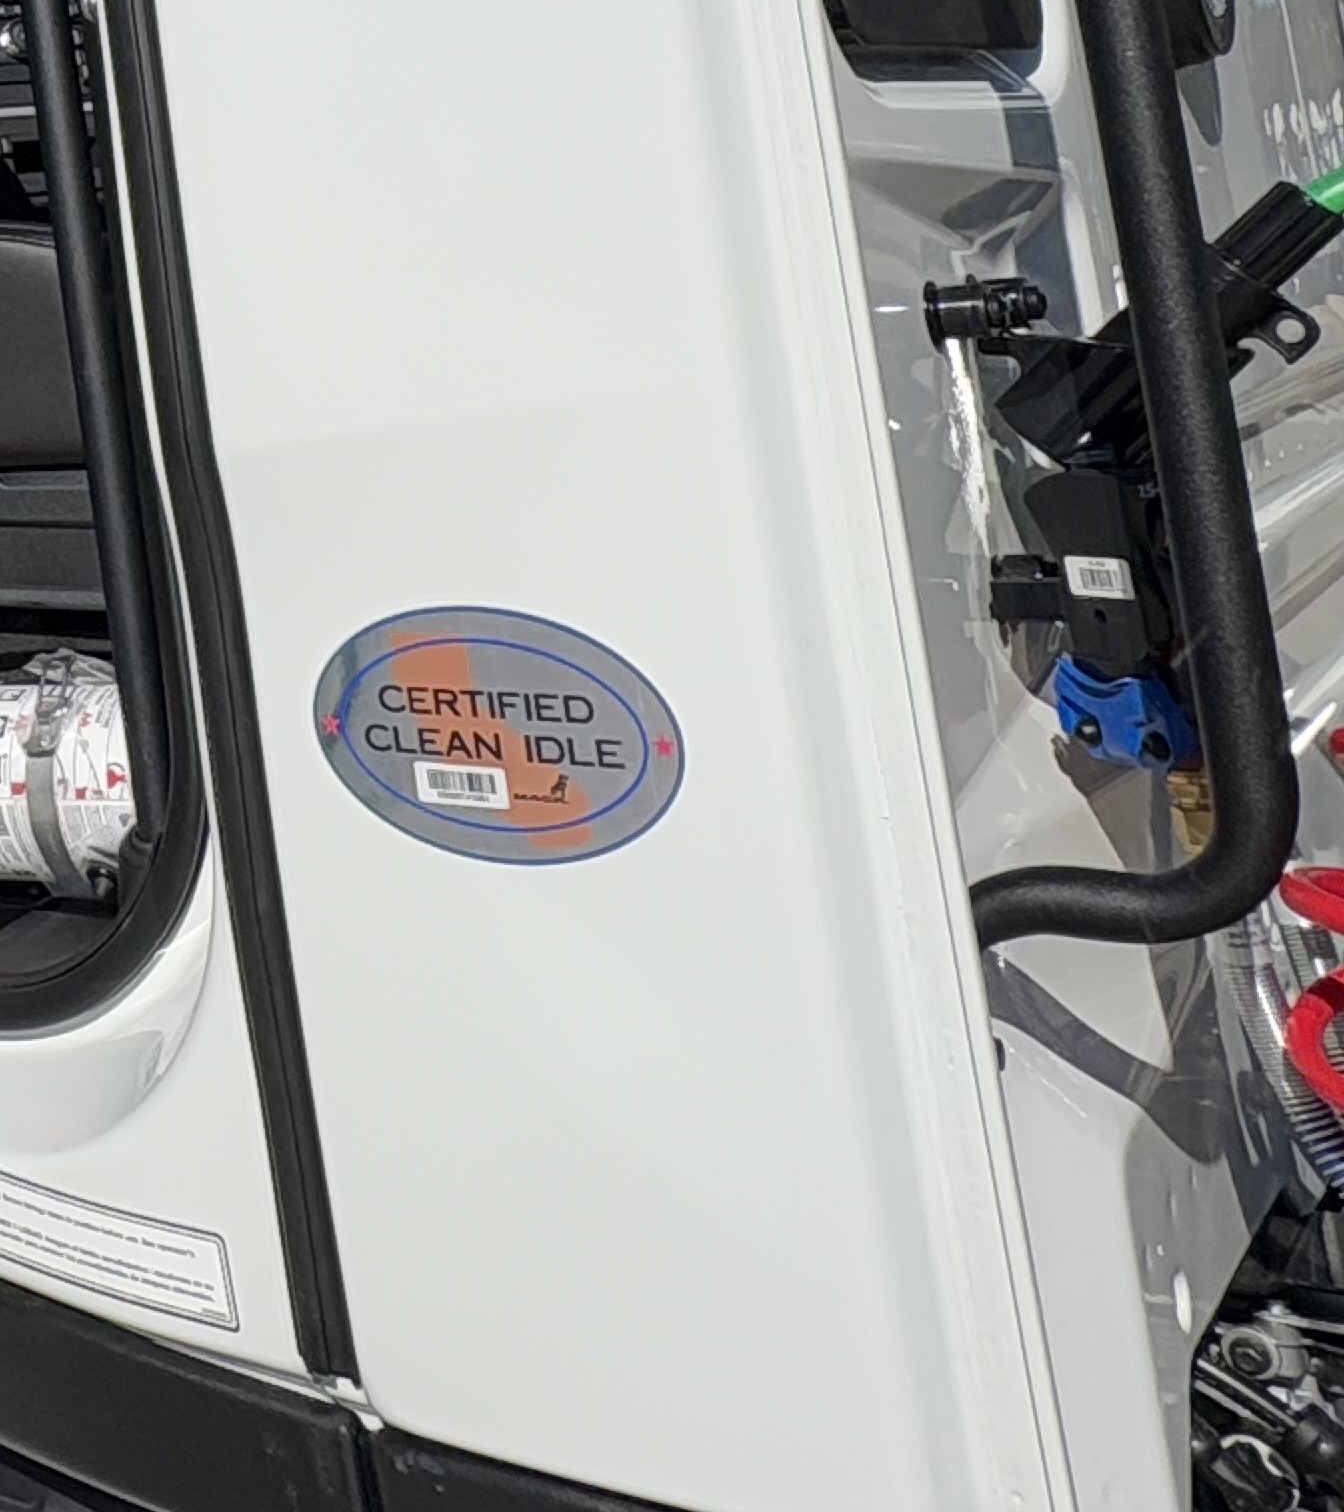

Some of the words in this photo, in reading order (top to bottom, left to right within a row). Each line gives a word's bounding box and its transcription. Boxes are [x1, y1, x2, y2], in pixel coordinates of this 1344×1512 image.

[378, 684, 595, 724] CERTIFIED
[364, 723, 504, 762] CLEAN
[523, 734, 627, 770] IDLE
